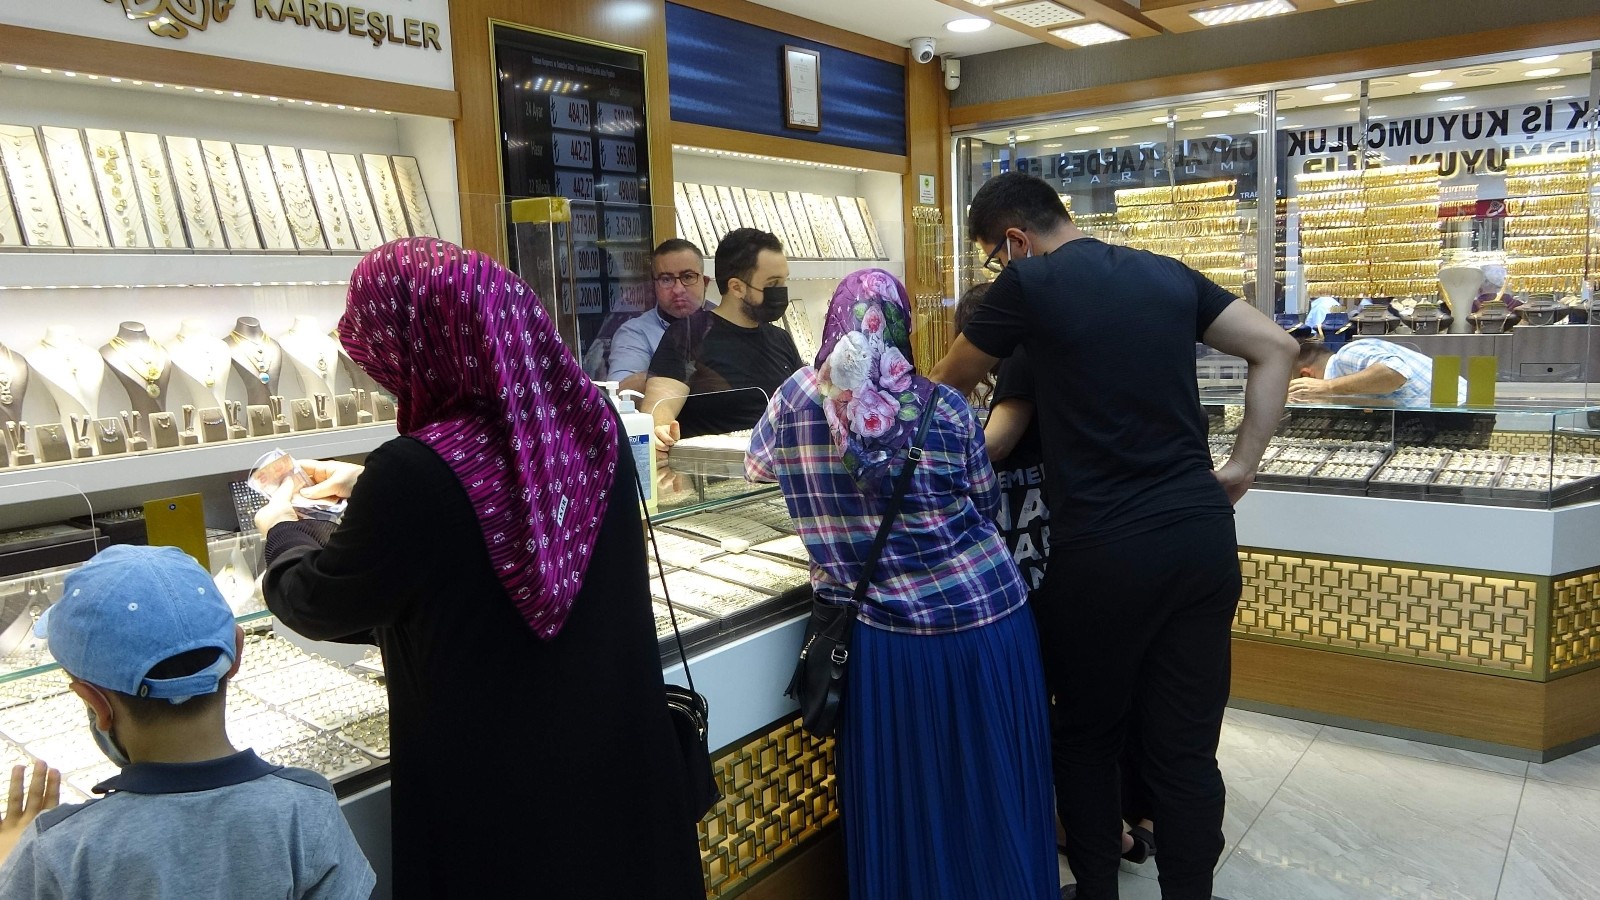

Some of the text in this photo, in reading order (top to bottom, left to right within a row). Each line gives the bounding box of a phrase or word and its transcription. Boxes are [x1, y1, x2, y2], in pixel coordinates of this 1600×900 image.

[253, 0, 441, 50] KARDEŞLER
[568, 102, 589, 126] 484,79
[571, 139, 591, 164] 442,27
[573, 177, 593, 200] 442,27
